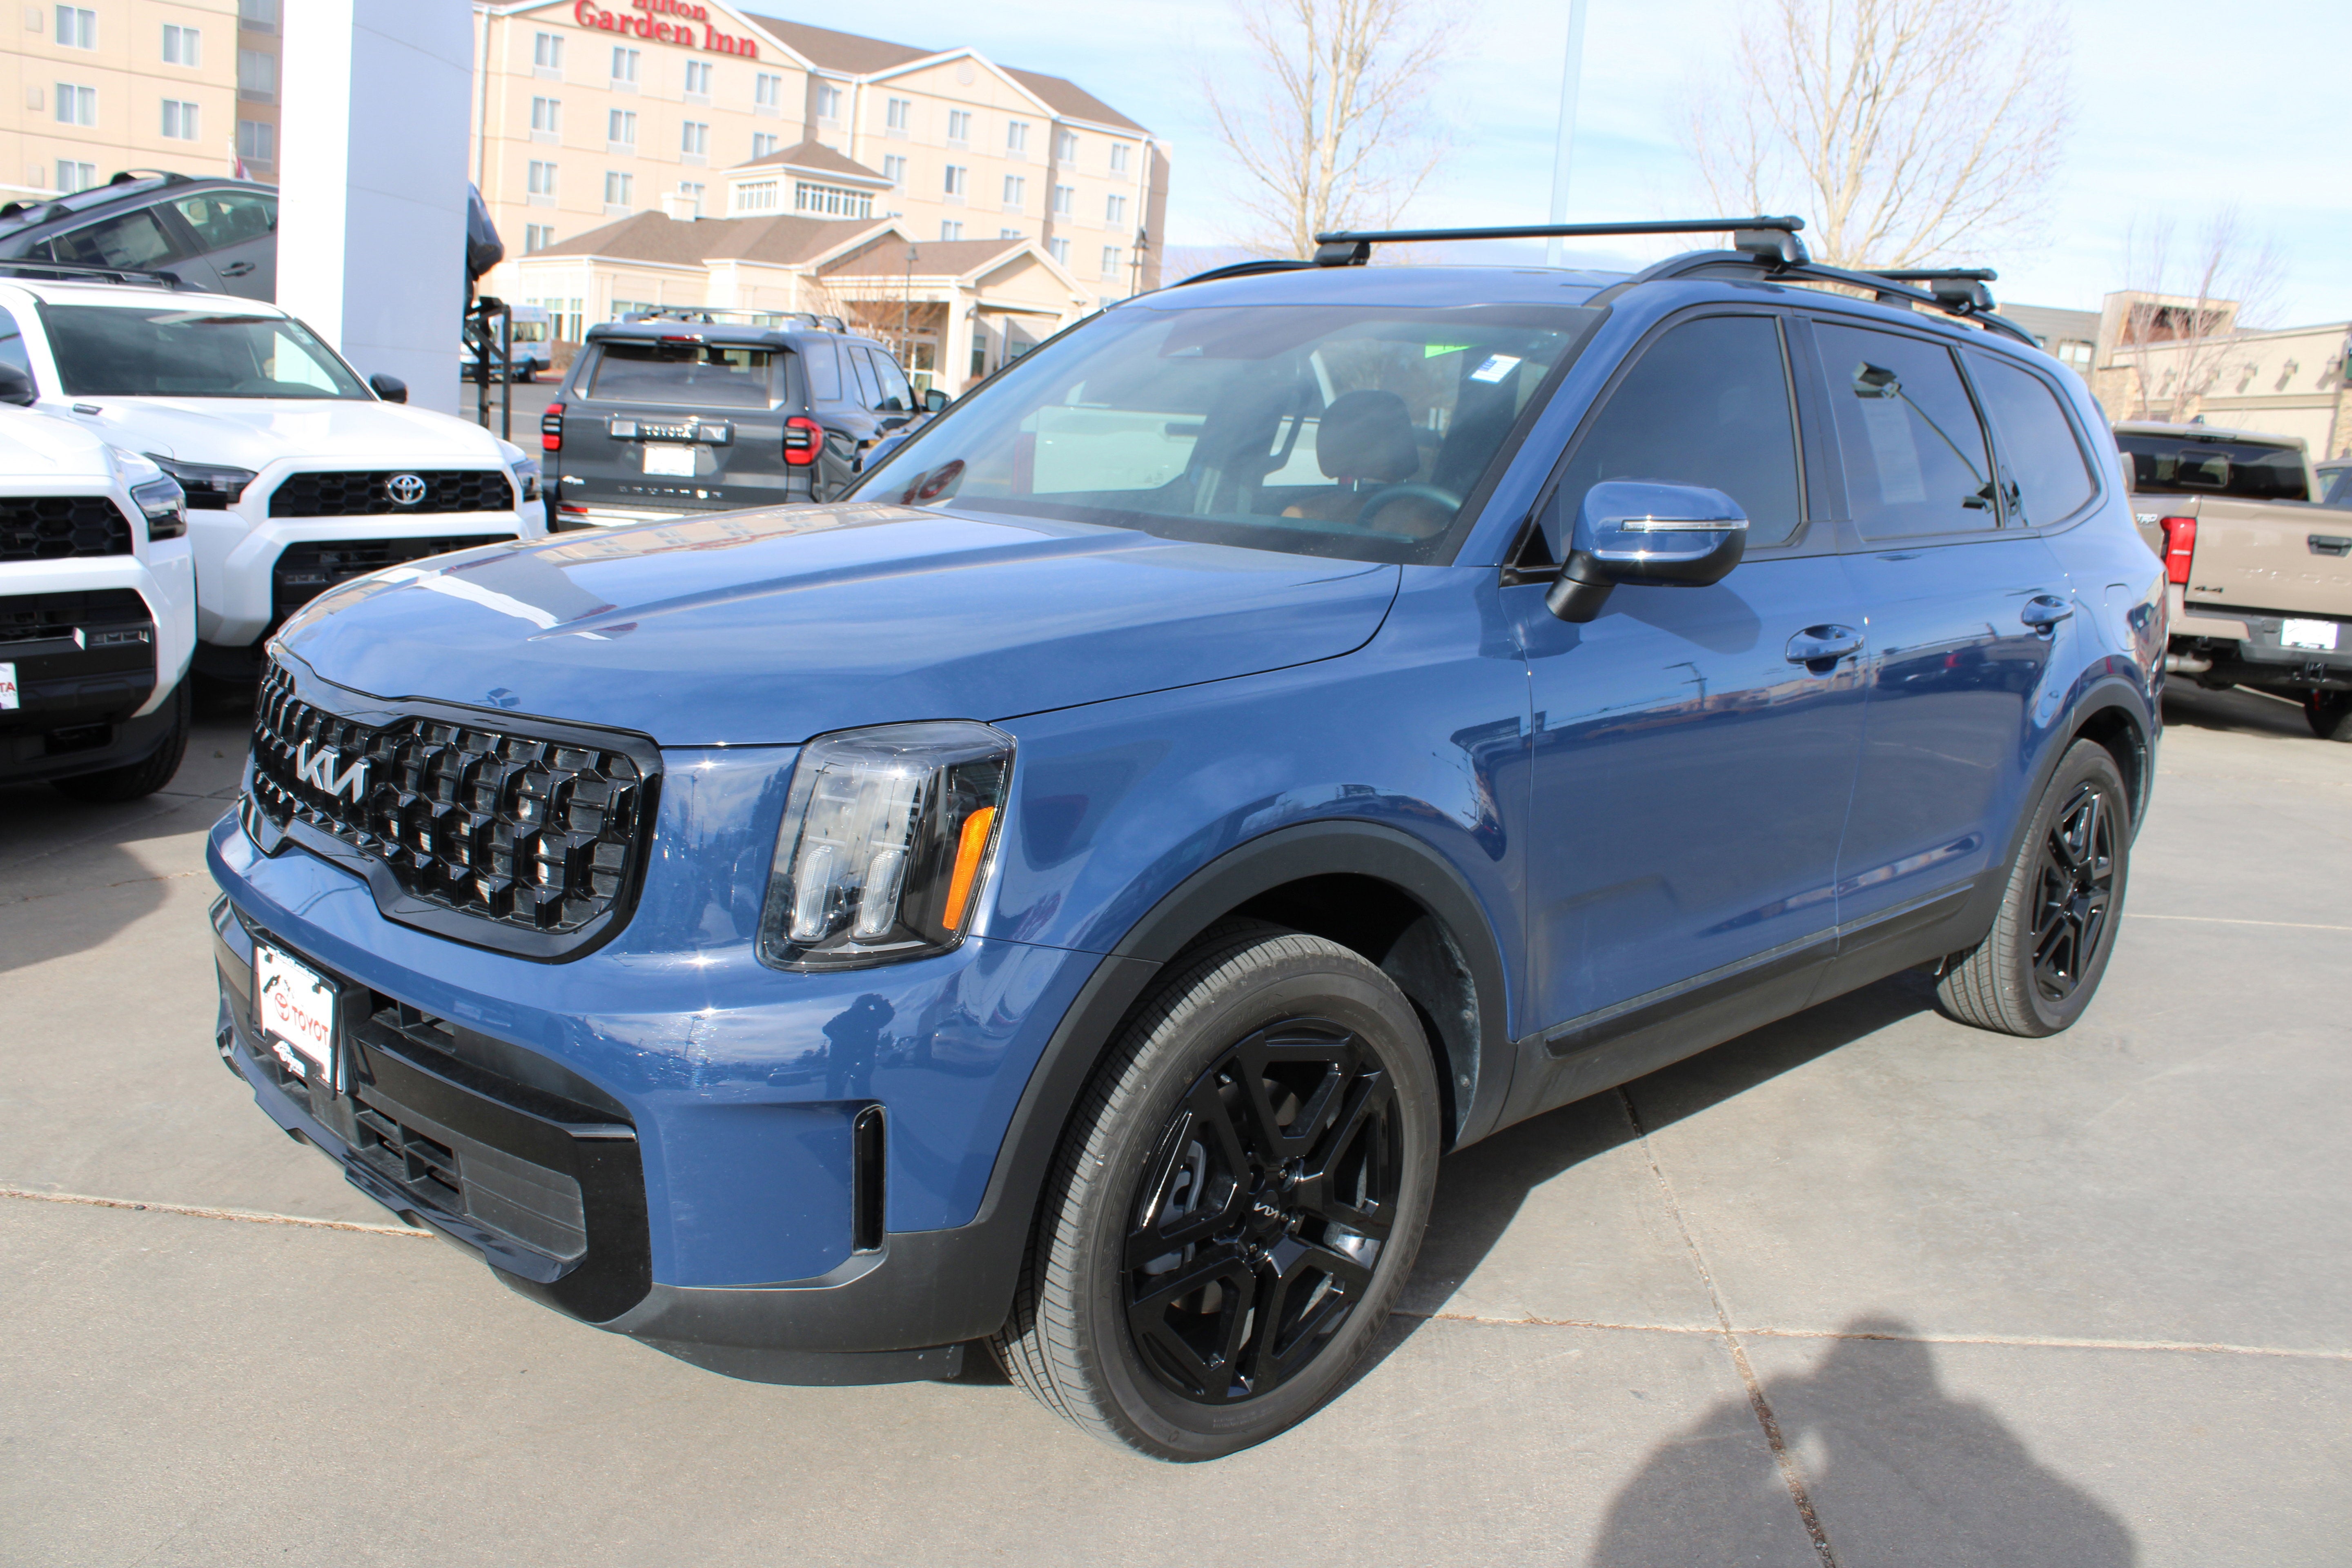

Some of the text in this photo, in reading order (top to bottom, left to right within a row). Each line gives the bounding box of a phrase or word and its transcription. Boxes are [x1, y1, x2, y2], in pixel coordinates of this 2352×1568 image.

[575, 0, 757, 58] Garden Inn
[292, 1005, 329, 1046] TOYOT
